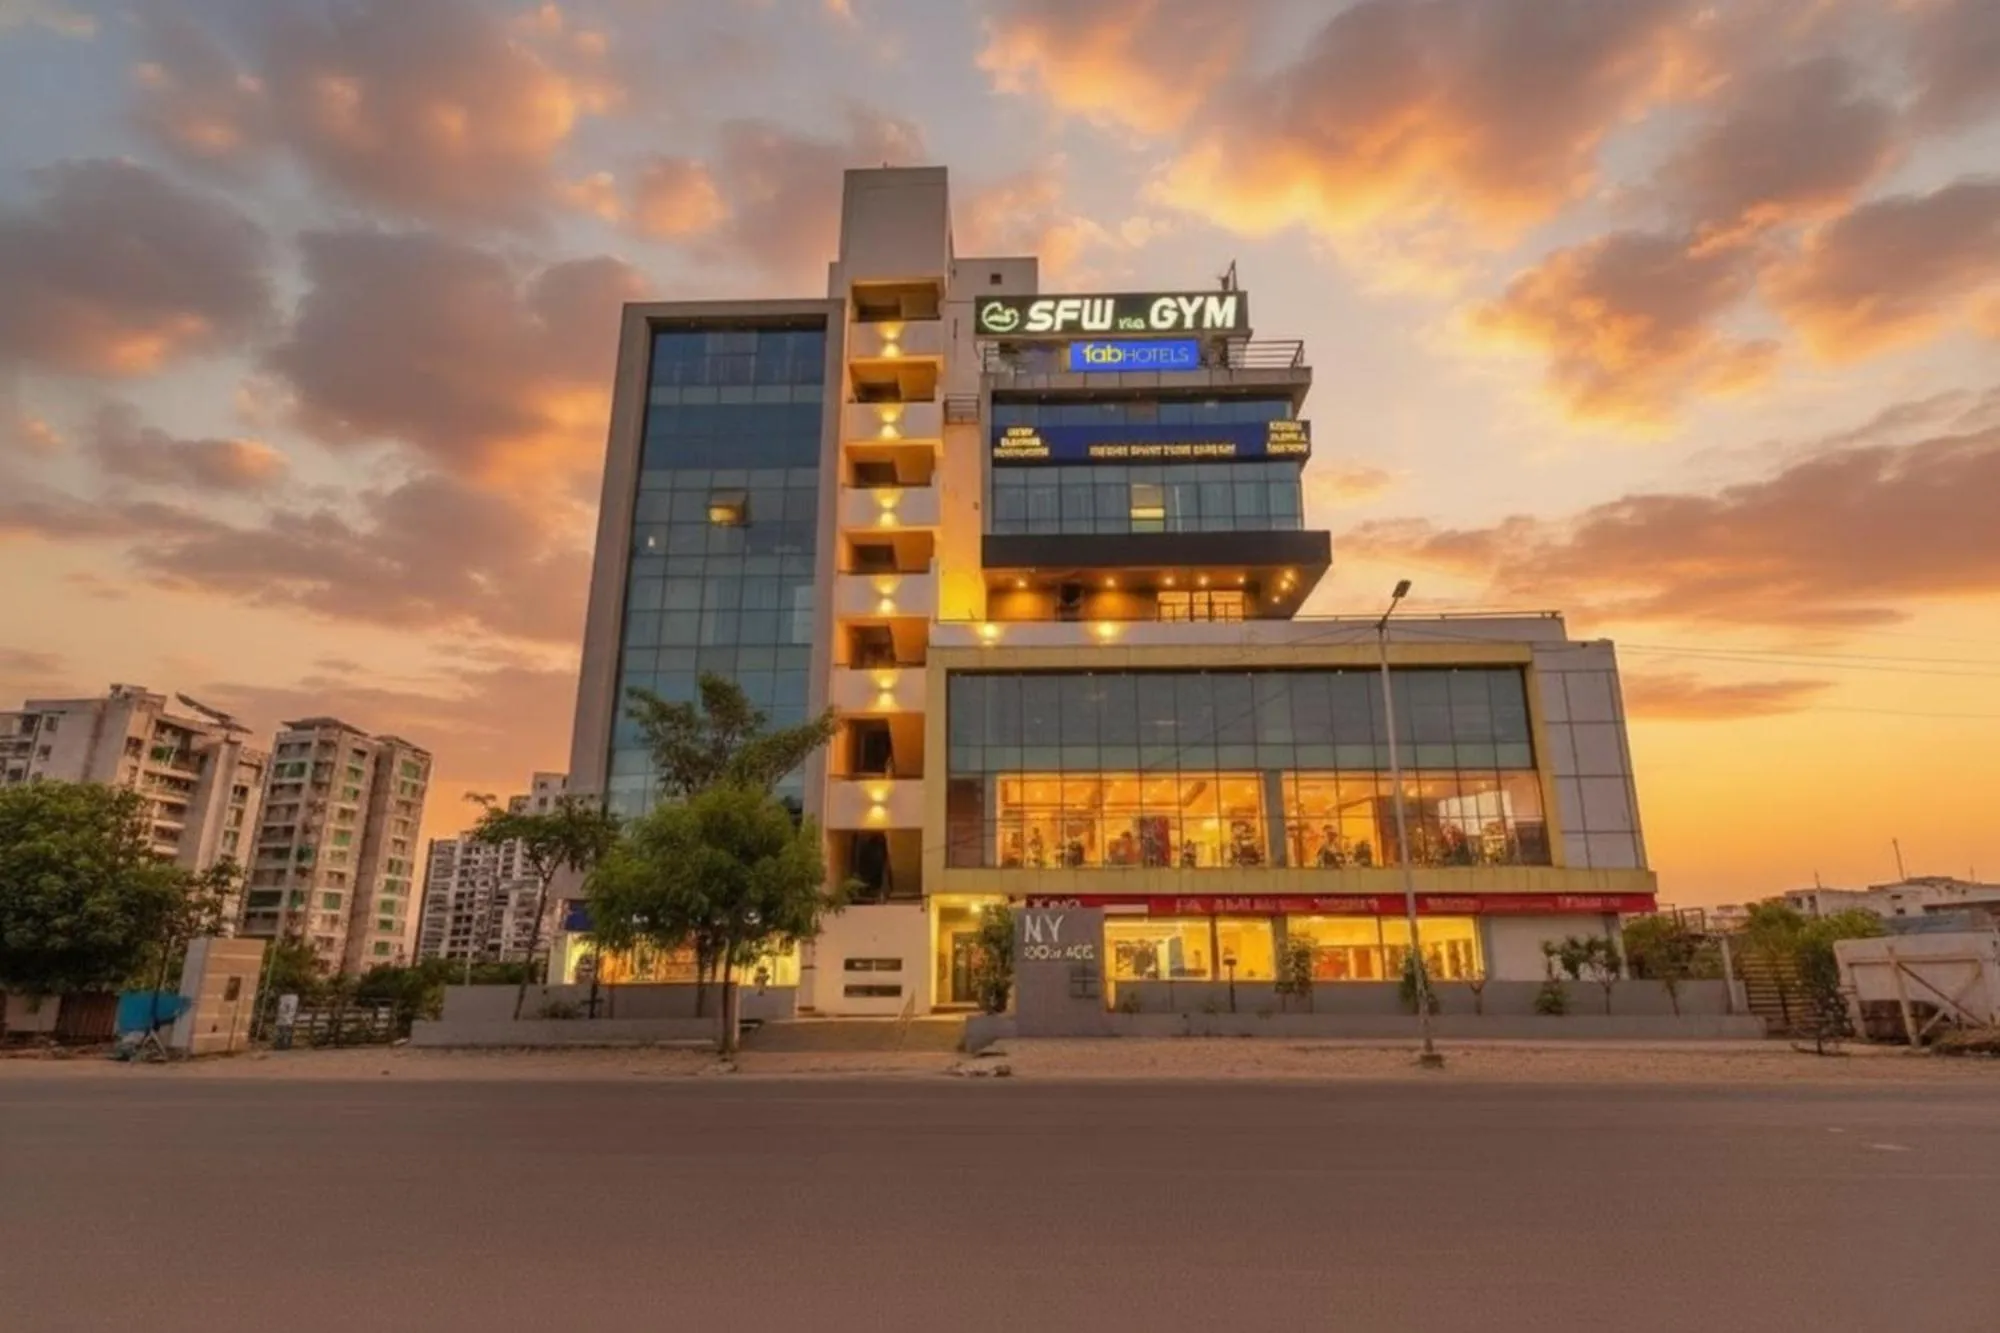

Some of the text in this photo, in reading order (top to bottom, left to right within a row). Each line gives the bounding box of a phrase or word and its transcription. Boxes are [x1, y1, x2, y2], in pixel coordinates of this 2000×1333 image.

[1025, 299, 1114, 331] SFW
[1150, 296, 1237, 329] GYM
[1083, 343, 1189, 364] fabHOTELS
[1024, 914, 1064, 943] NY
